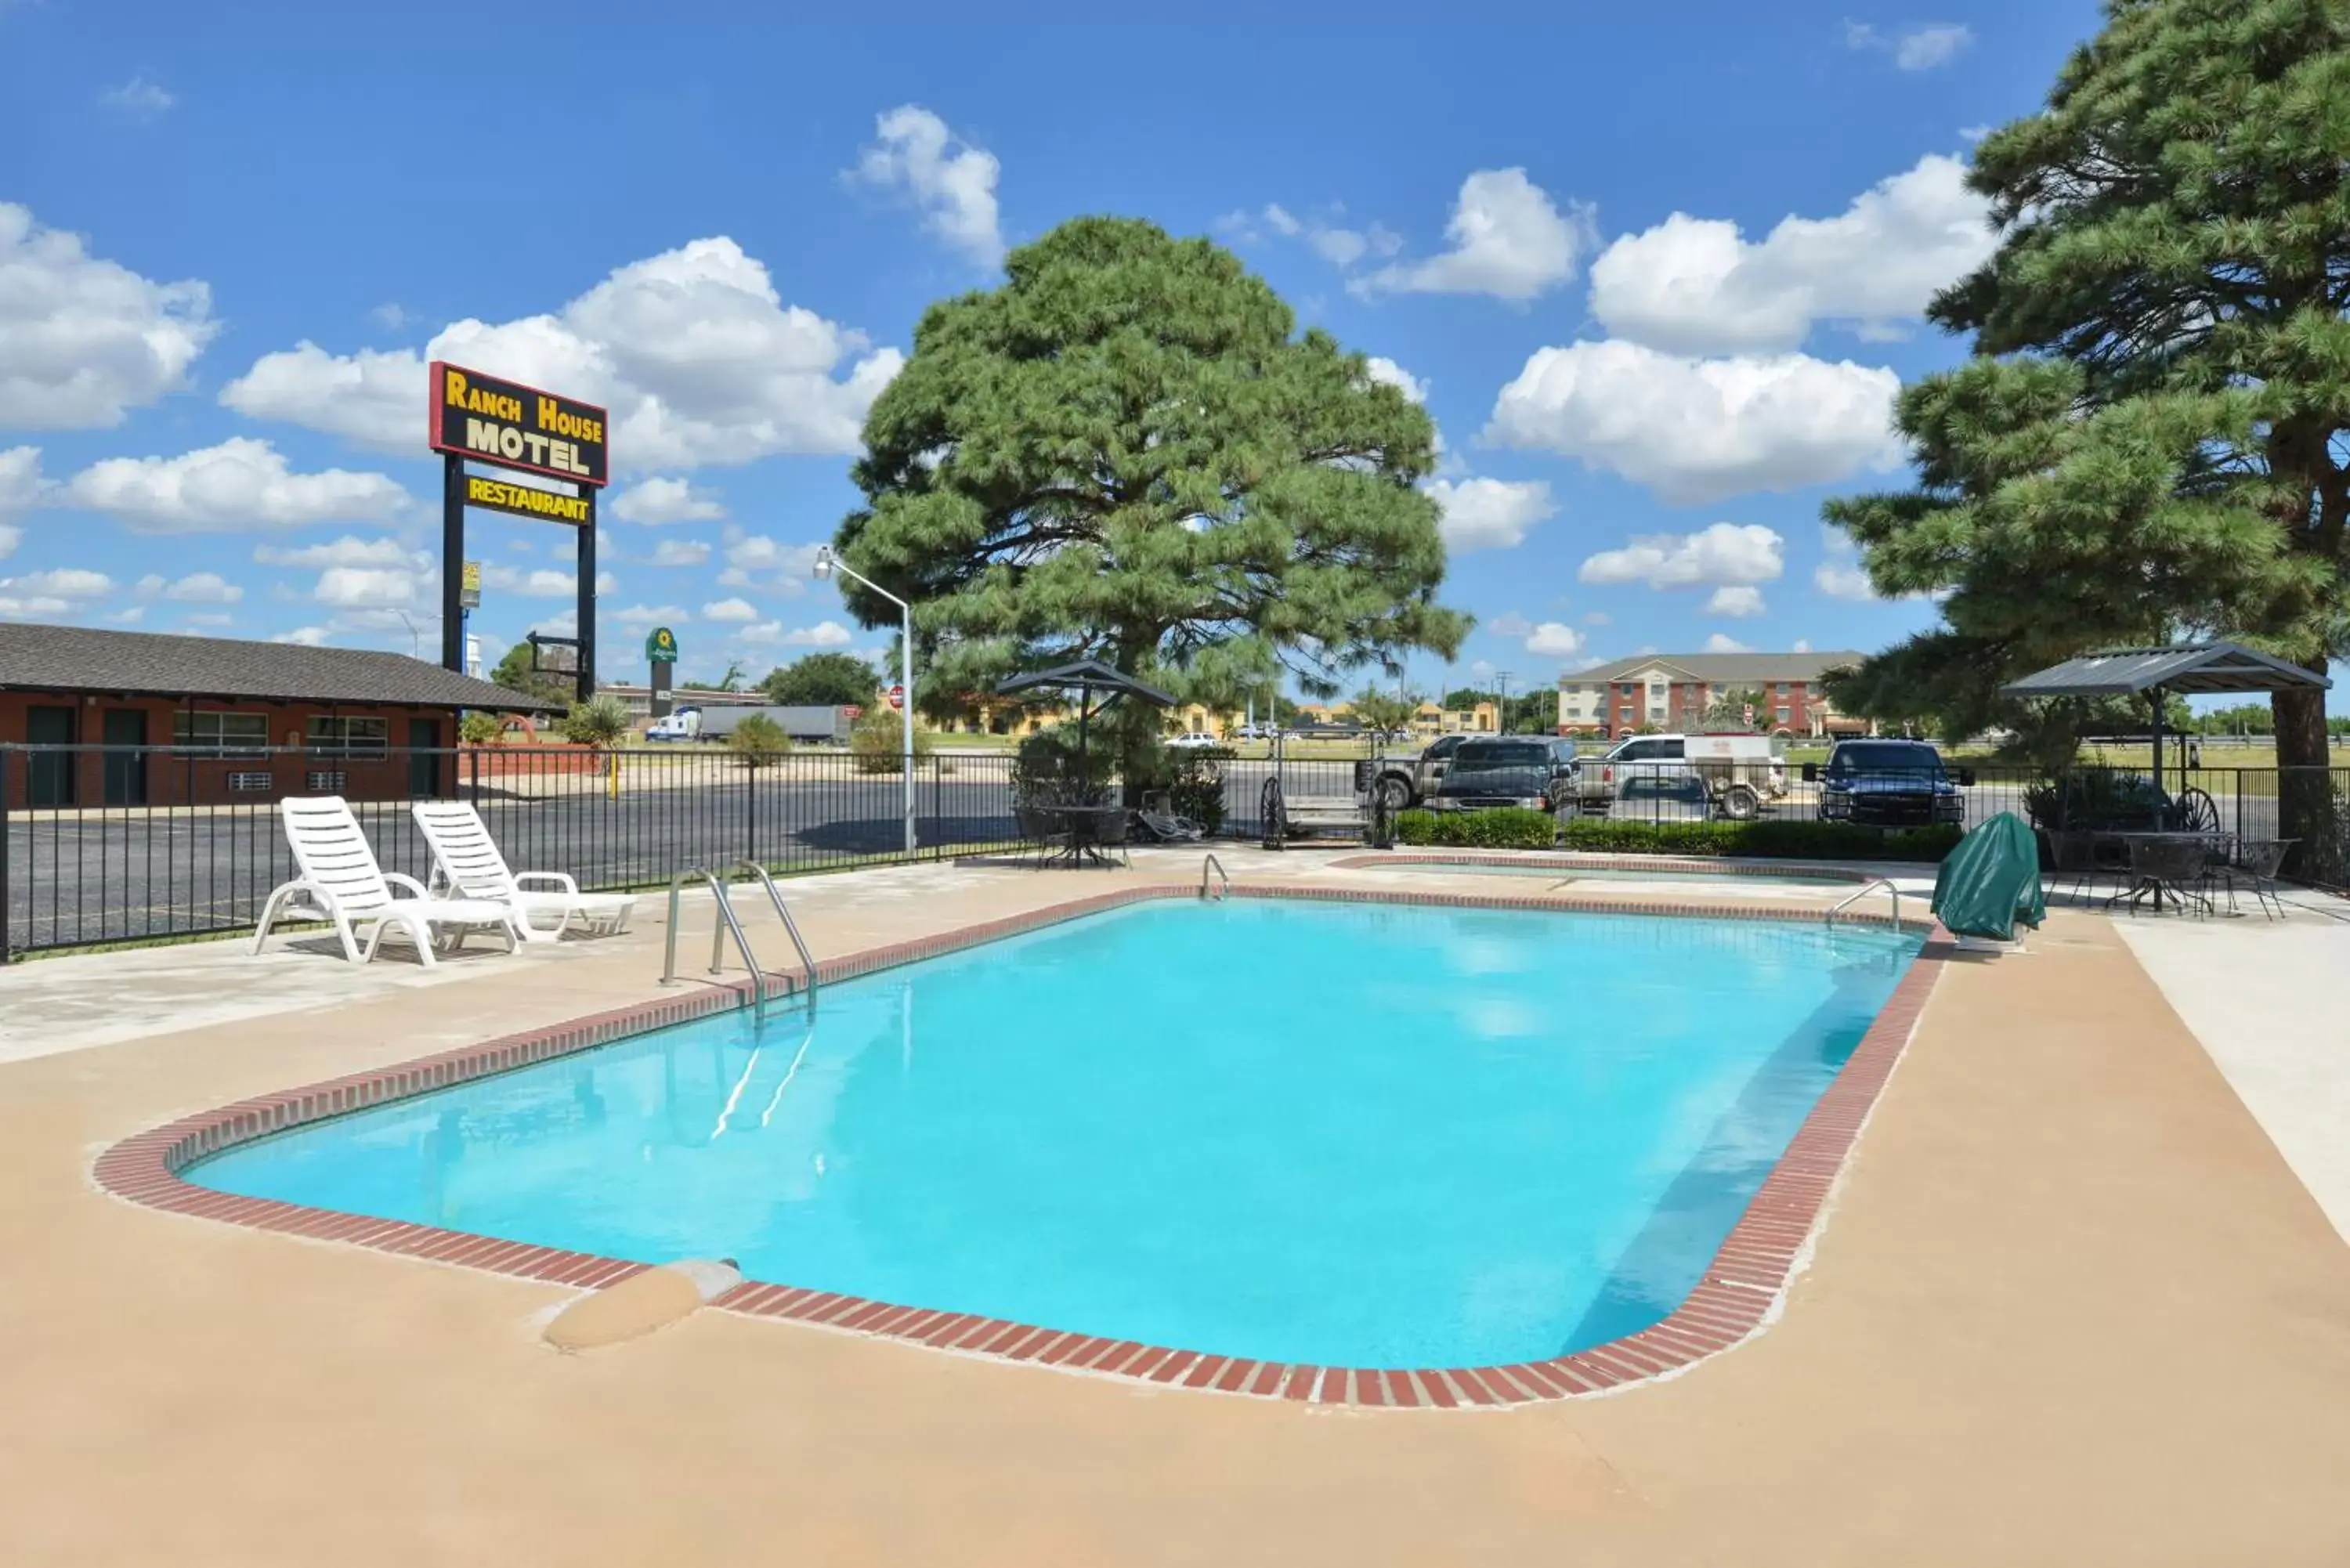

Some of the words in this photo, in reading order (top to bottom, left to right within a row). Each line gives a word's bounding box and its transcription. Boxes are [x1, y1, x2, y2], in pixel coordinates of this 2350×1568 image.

[446, 370, 521, 422] RANCH
[538, 396, 602, 443] HOUSE
[466, 417, 589, 475] MOTEL
[469, 479, 588, 521] RESTAURANT
